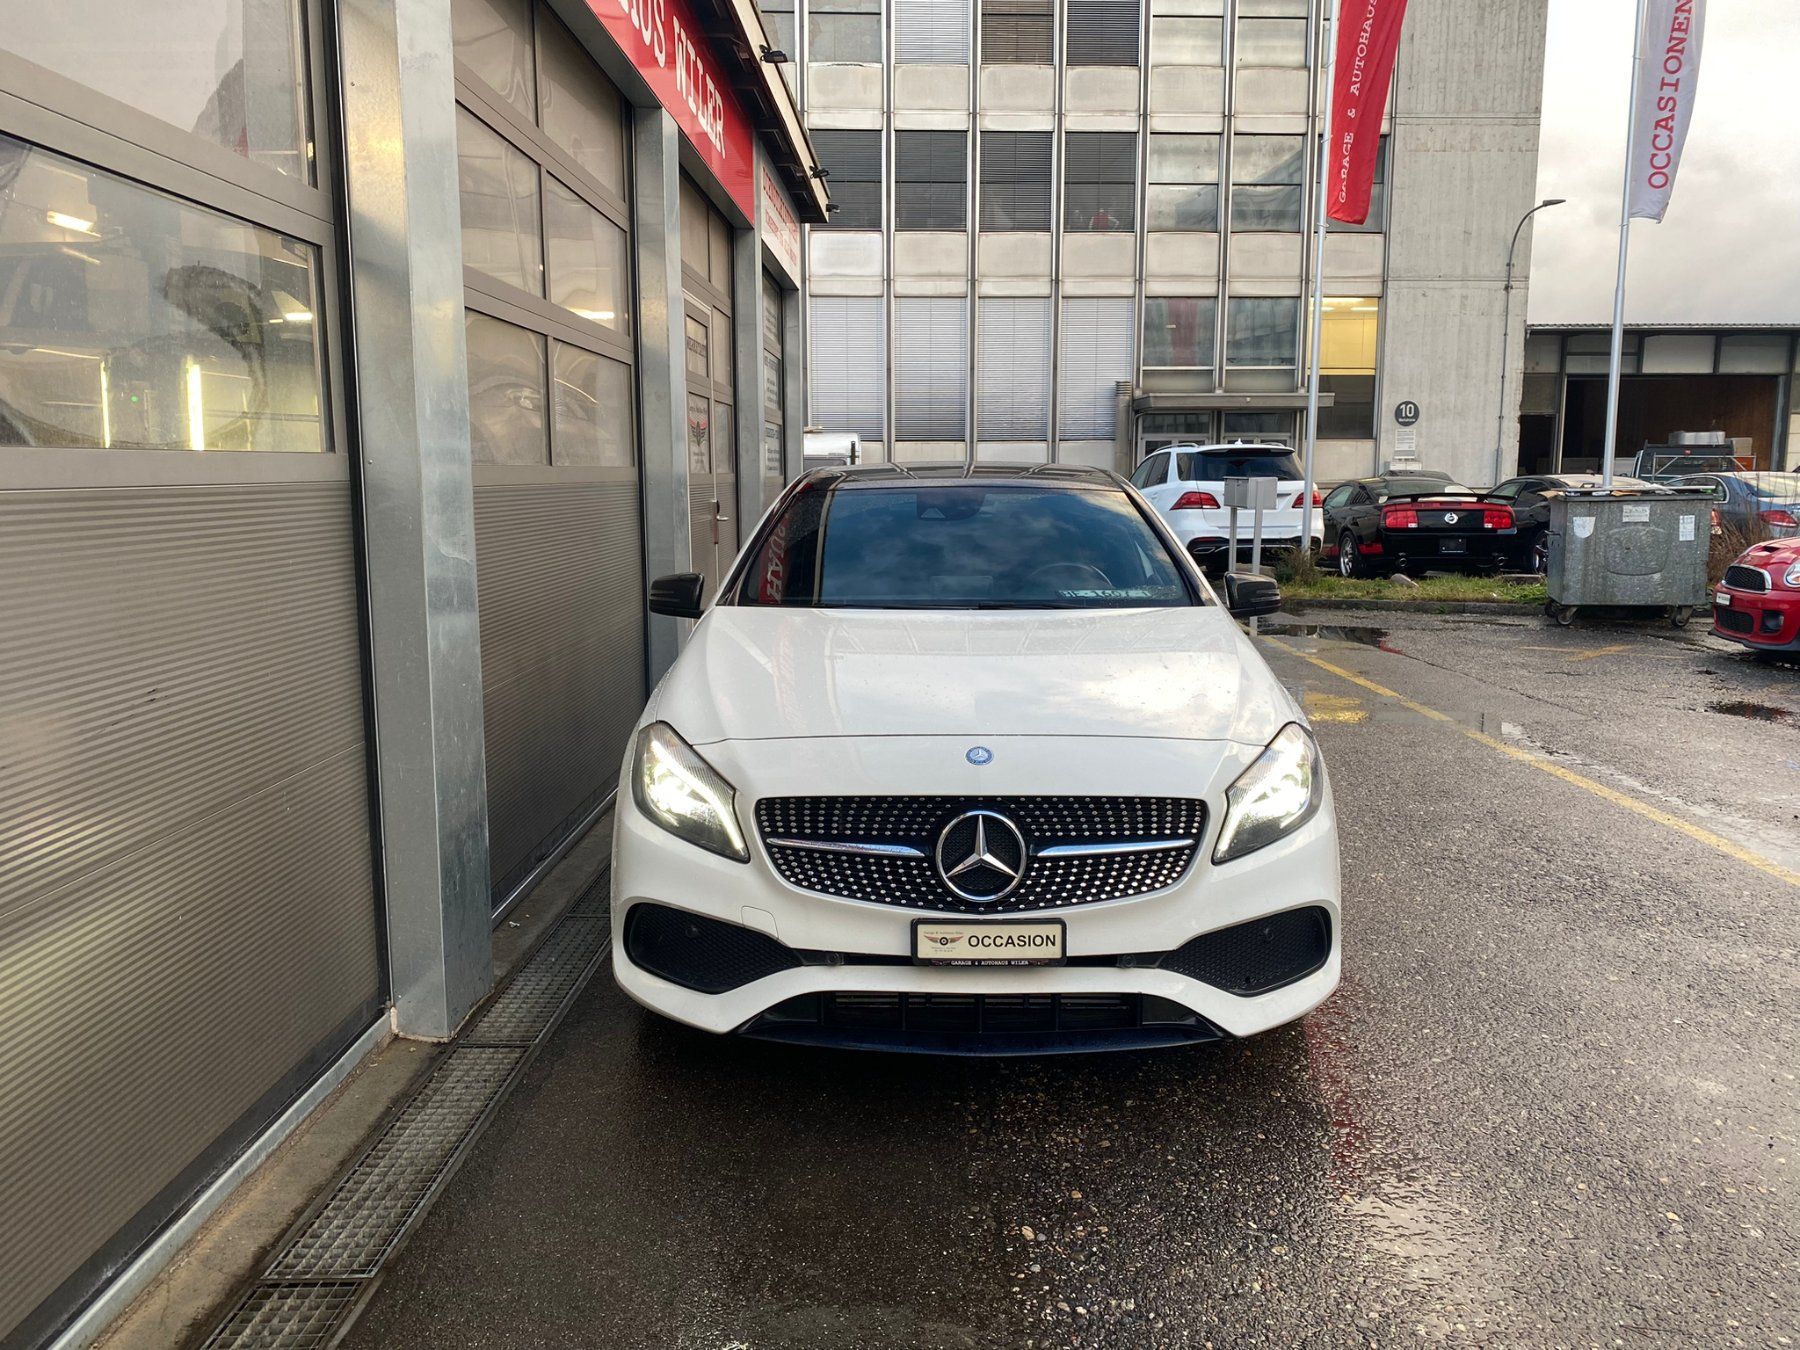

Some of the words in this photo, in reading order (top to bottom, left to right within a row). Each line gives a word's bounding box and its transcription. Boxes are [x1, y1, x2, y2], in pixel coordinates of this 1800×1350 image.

[672, 15, 726, 160] WILER
[1647, 0, 1694, 190] OCCASIONEN
[1339, 131, 1355, 203] GARAGE
[1347, 107, 1356, 119] &
[1399, 403, 1415, 418] 10
[967, 934, 1057, 948] OCCASION
